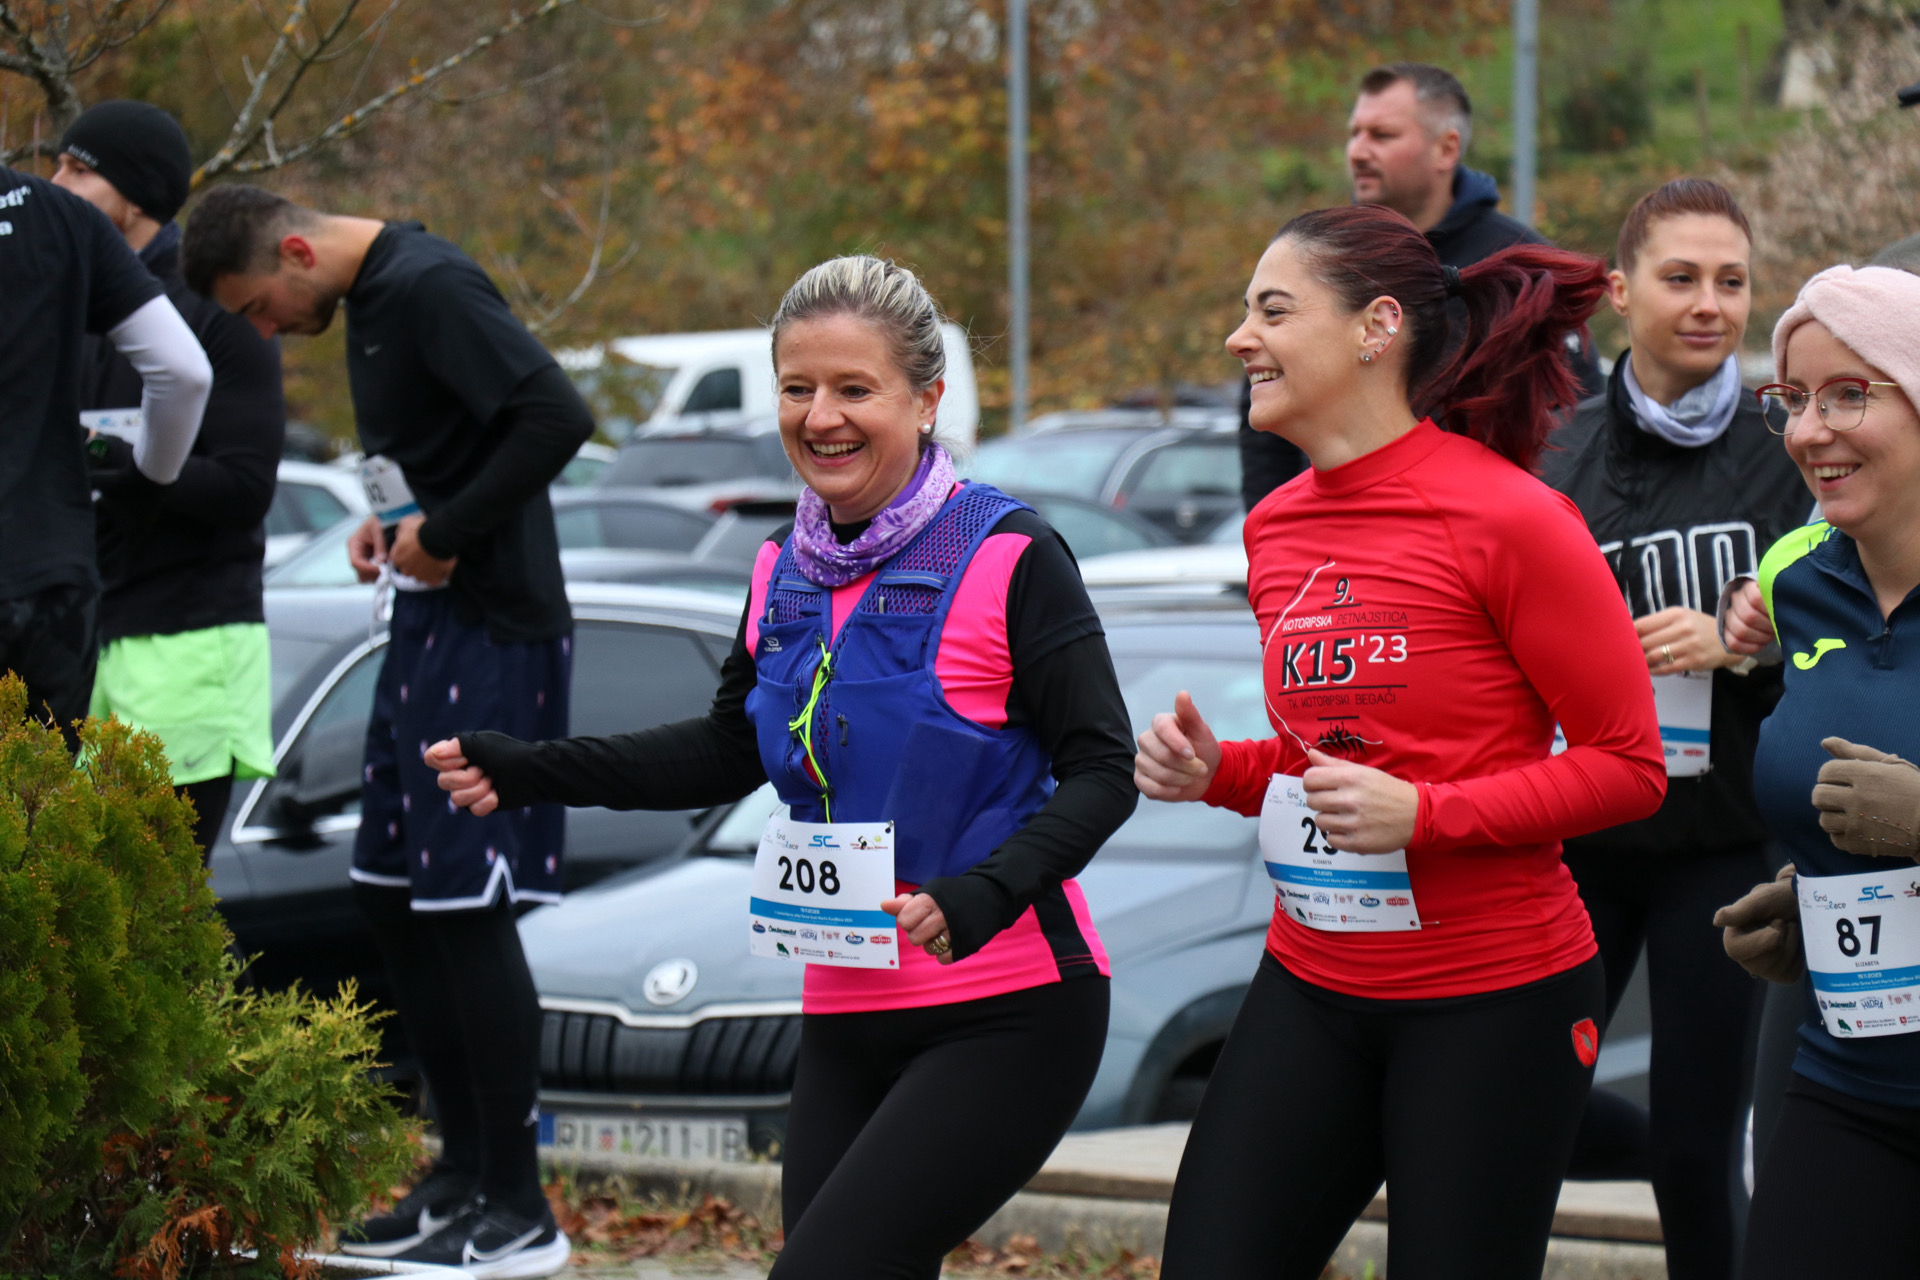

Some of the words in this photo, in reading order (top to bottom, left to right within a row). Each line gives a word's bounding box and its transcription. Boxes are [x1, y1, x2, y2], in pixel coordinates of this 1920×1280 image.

[1333, 577, 1354, 604] 9.
[1282, 615, 1332, 632] KOTORIPSKA
[1336, 611, 1408, 625] PETNAJSTICA
[1288, 699, 1298, 710] TK
[1302, 694, 1350, 708] KOTORIPSKI
[1355, 688, 1396, 706] BEGAČI
[808, 835, 841, 848] SC
[778, 855, 841, 896] 208
[1858, 885, 1895, 901] SC
[1836, 915, 1881, 957] 87
